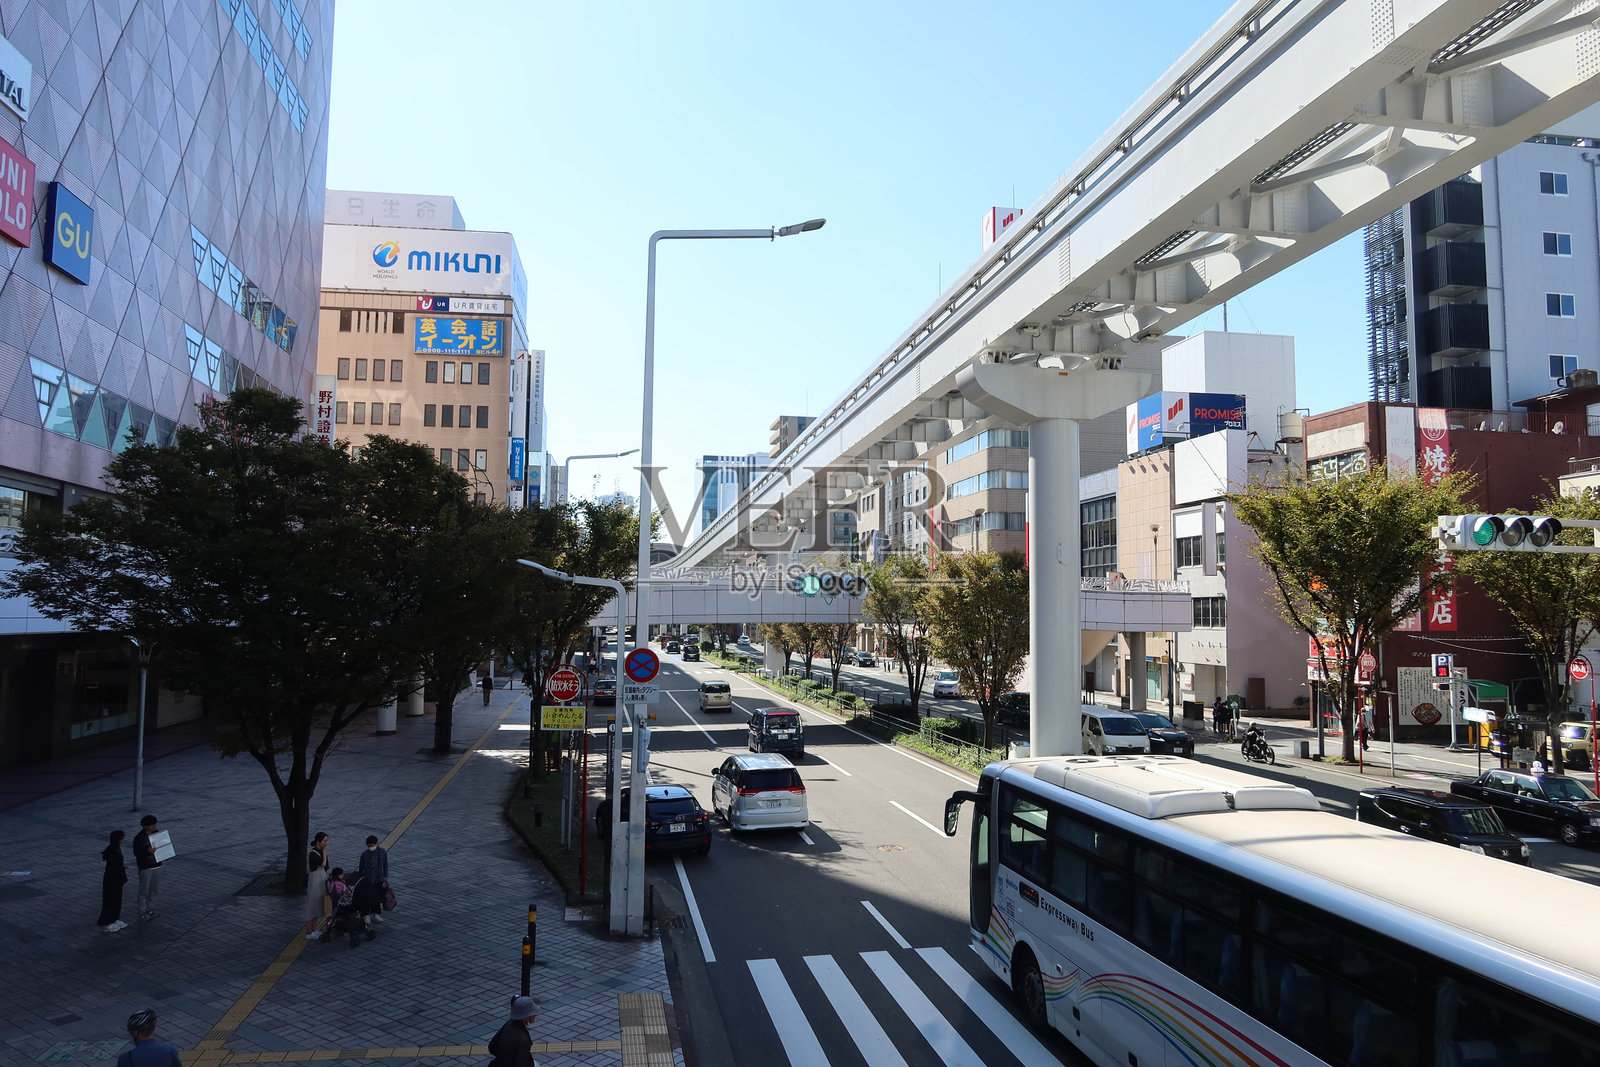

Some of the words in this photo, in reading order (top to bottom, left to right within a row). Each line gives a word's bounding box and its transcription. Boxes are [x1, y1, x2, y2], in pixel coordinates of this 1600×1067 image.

[0, 189, 26, 231] LO
[326, 197, 437, 221] 日生命
[57, 212, 91, 260] GU
[420, 318, 498, 337] 英会話
[419, 333, 498, 350] イーオン
[1138, 412, 1161, 429] PROMISE
[1194, 408, 1242, 421] PROMISE
[1040, 897, 1080, 934] Expressway
[1081, 922, 1095, 942] Bus
